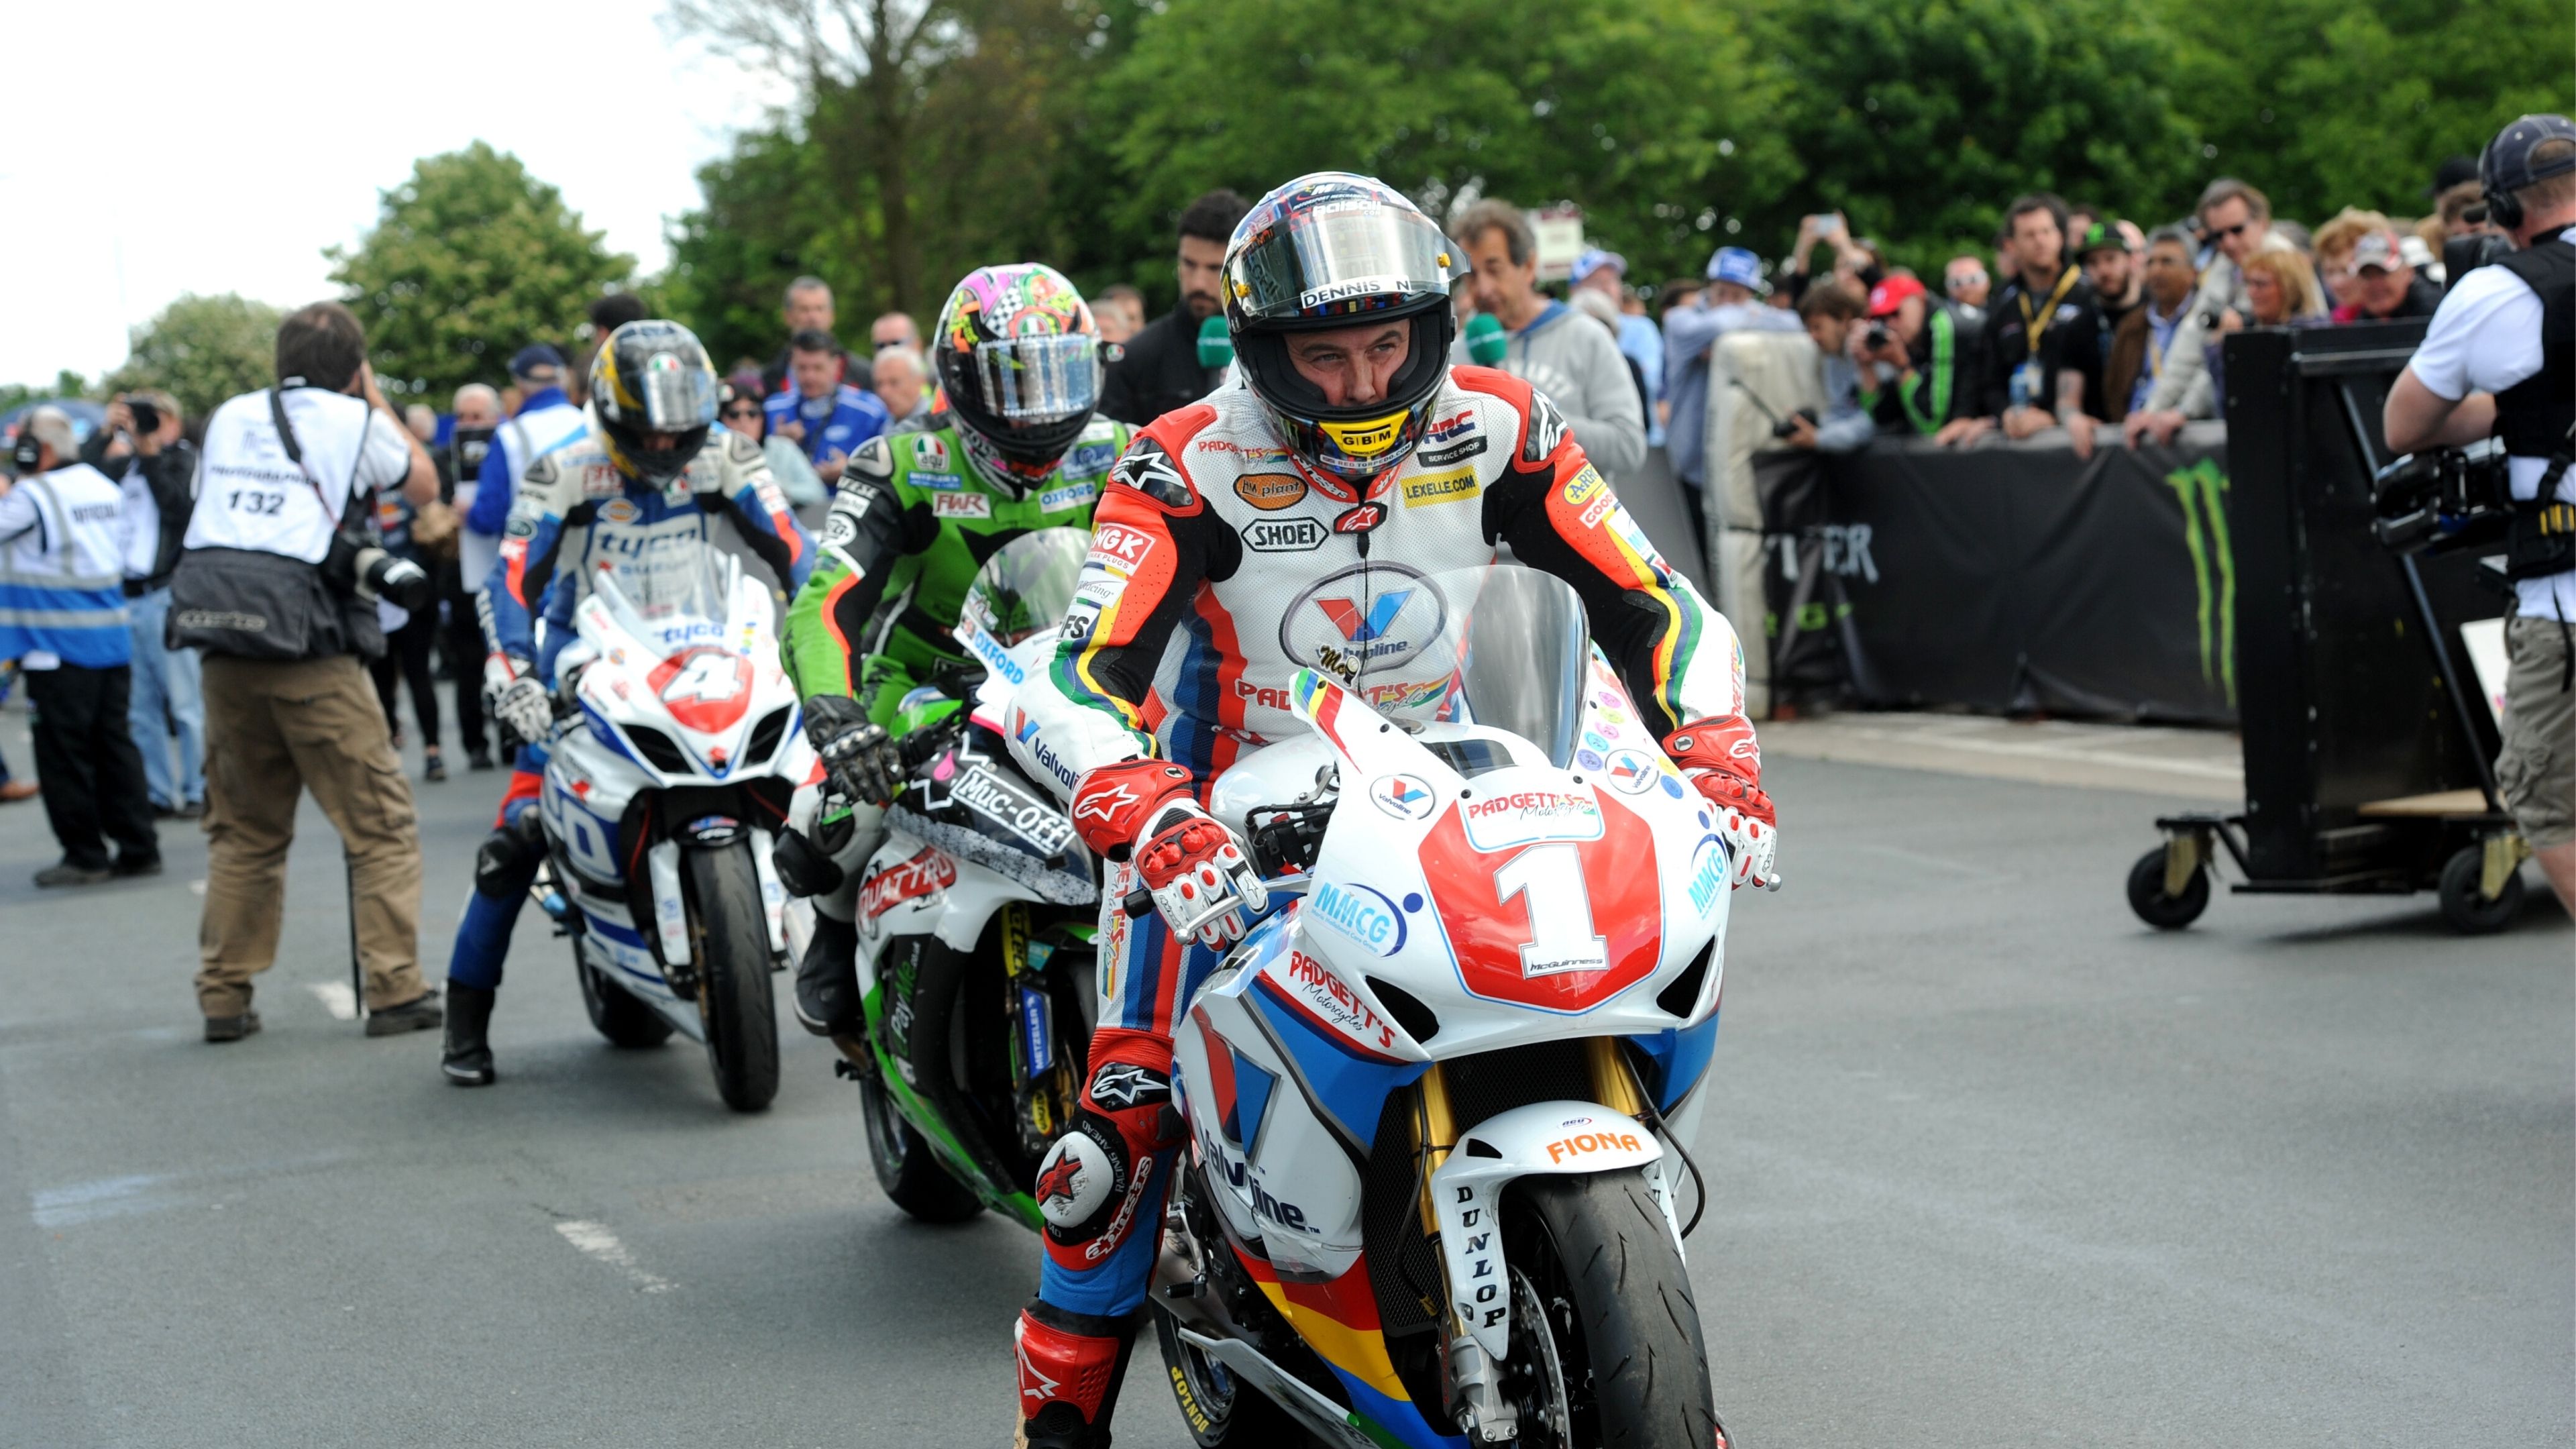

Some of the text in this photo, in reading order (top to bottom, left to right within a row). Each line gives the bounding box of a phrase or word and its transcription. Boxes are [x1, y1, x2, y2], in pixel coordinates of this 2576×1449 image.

[1303, 280, 1409, 307] DENNIS N
[1424, 409, 1477, 445] HRC
[1357, 443, 1411, 468] TORPEDO.COM
[1428, 441, 1481, 463] SERVICE SHOP
[1041, 483, 1094, 505] OXFORD
[1262, 480, 1300, 497] plant
[1405, 474, 1477, 499] LEXELLE.COM
[229, 489, 286, 516] 132
[1091, 528, 1144, 559] NGK
[1254, 523, 1317, 547] SHOEI
[1102, 554, 1130, 570] PLUGS
[974, 630, 1025, 685] OXFORD
[659, 651, 743, 702] 4
[1631, 764, 1653, 789] Valvoline
[957, 771, 1073, 851] Muc-Off
[1378, 792, 1413, 816] Valvoline
[1468, 792, 1576, 819] PADGETT'S
[1687, 847, 1724, 914] MMCG
[1313, 881, 1391, 944] MMCG
[1493, 843, 1610, 979] 1
[1362, 940, 1379, 954] Group
[1289, 950, 1397, 1049] PADGETT'S
[1301, 981, 1363, 1031] Motorcycles
[1029, 1008, 1045, 1070] METZELER
[1081, 1119, 1113, 1150] AHEAD
[1546, 1132, 1642, 1165] FIONA
[1108, 1152, 1127, 1193] RACING
[1457, 1186, 1507, 1329] DUNLOP
[1171, 1366, 1210, 1434] DUNLOP
